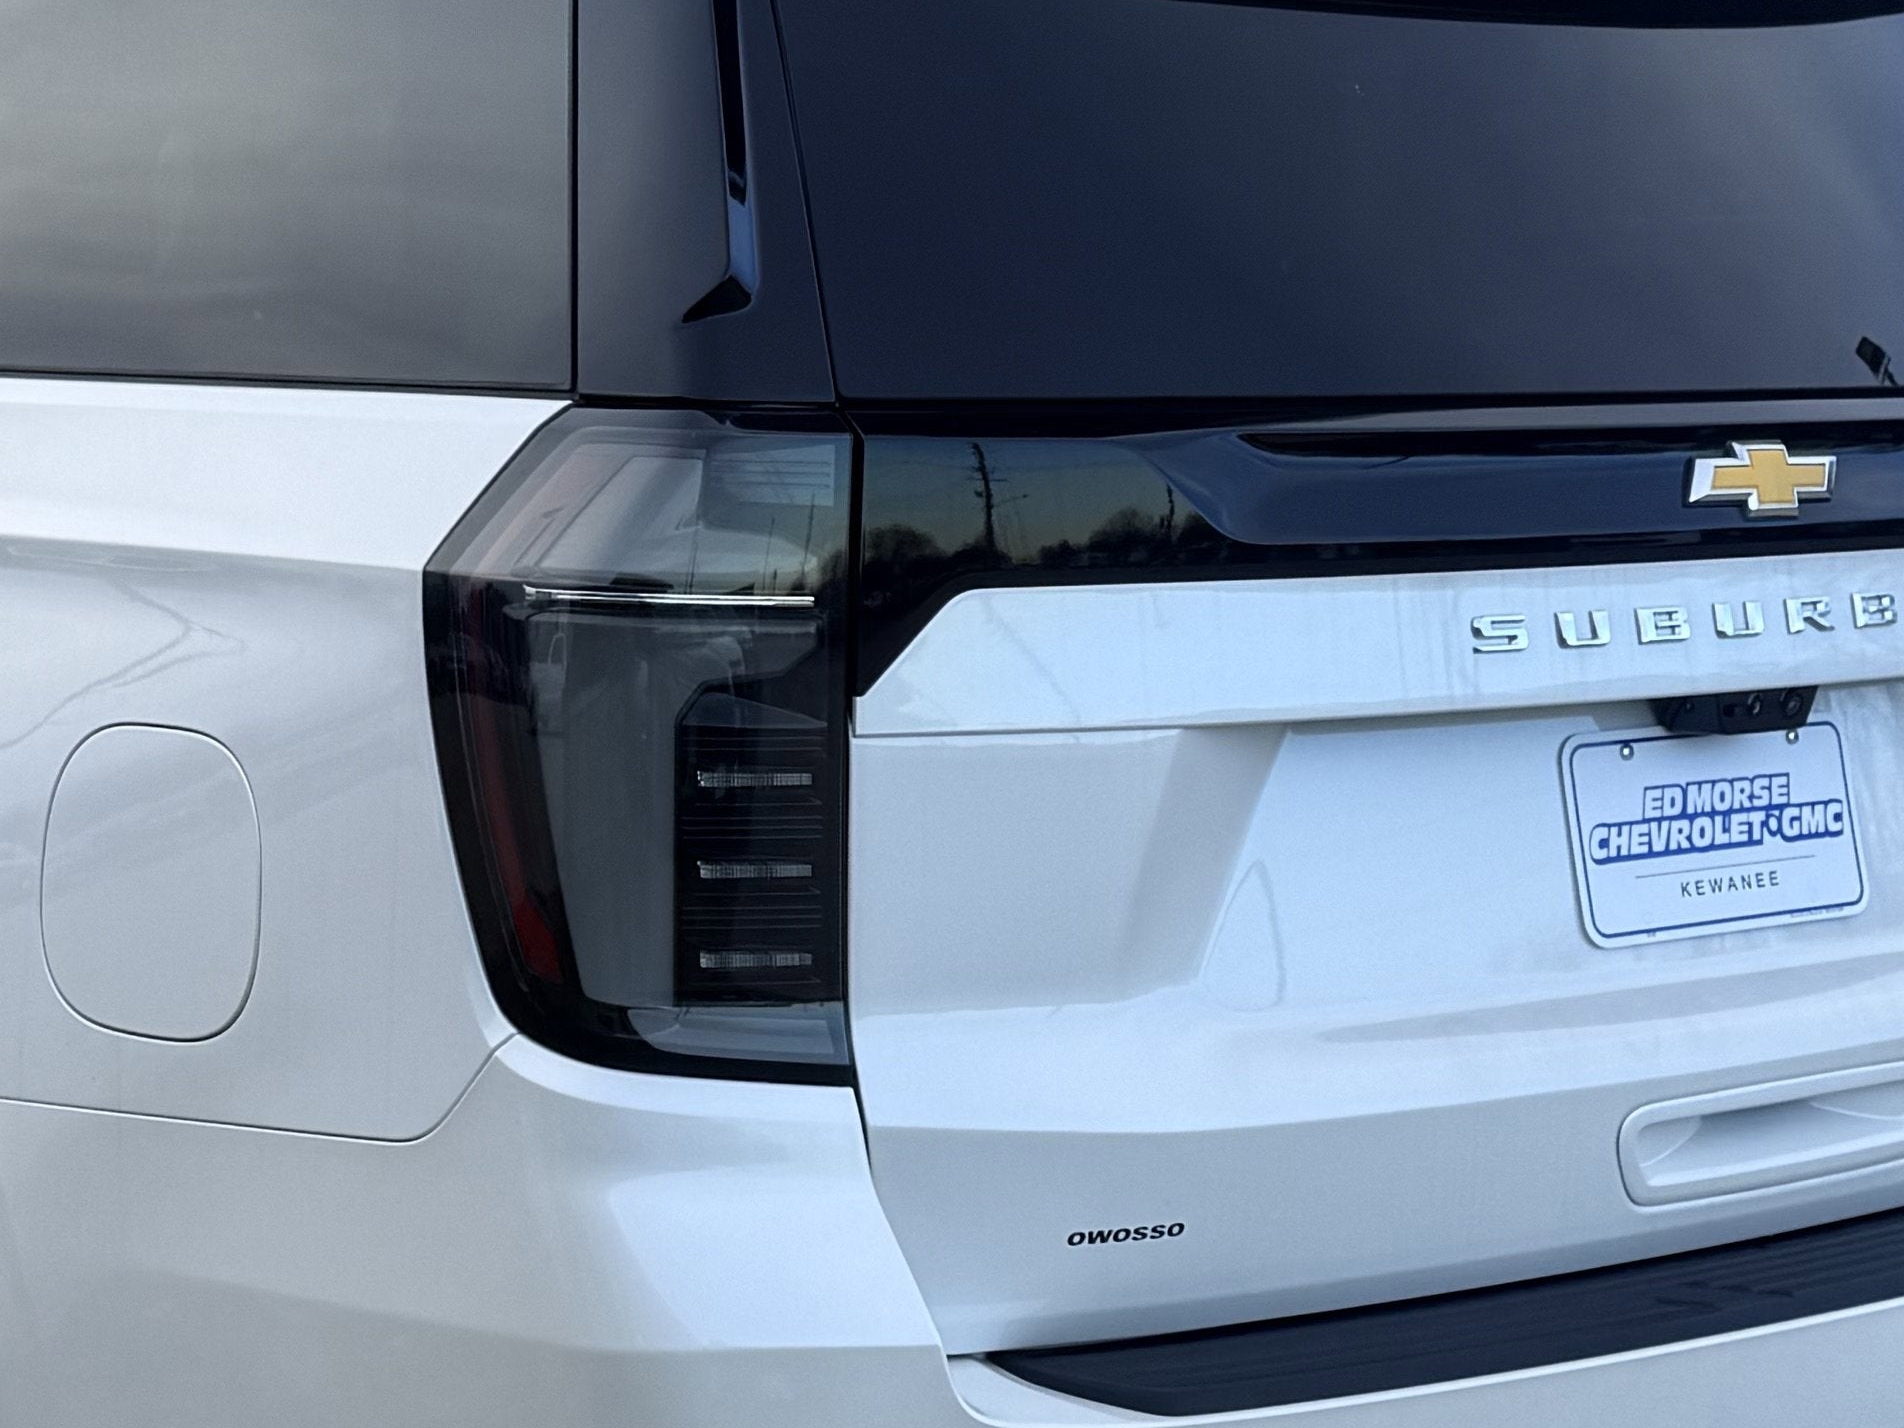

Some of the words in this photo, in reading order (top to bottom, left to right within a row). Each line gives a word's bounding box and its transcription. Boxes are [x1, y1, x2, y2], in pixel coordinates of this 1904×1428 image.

[1644, 784, 1685, 820] ED
[1686, 773, 1790, 814] MORSE
[1590, 812, 1766, 863] CHEVROLET
[1780, 800, 1840, 842] GMC
[1680, 870, 1780, 898] KEWANEE
